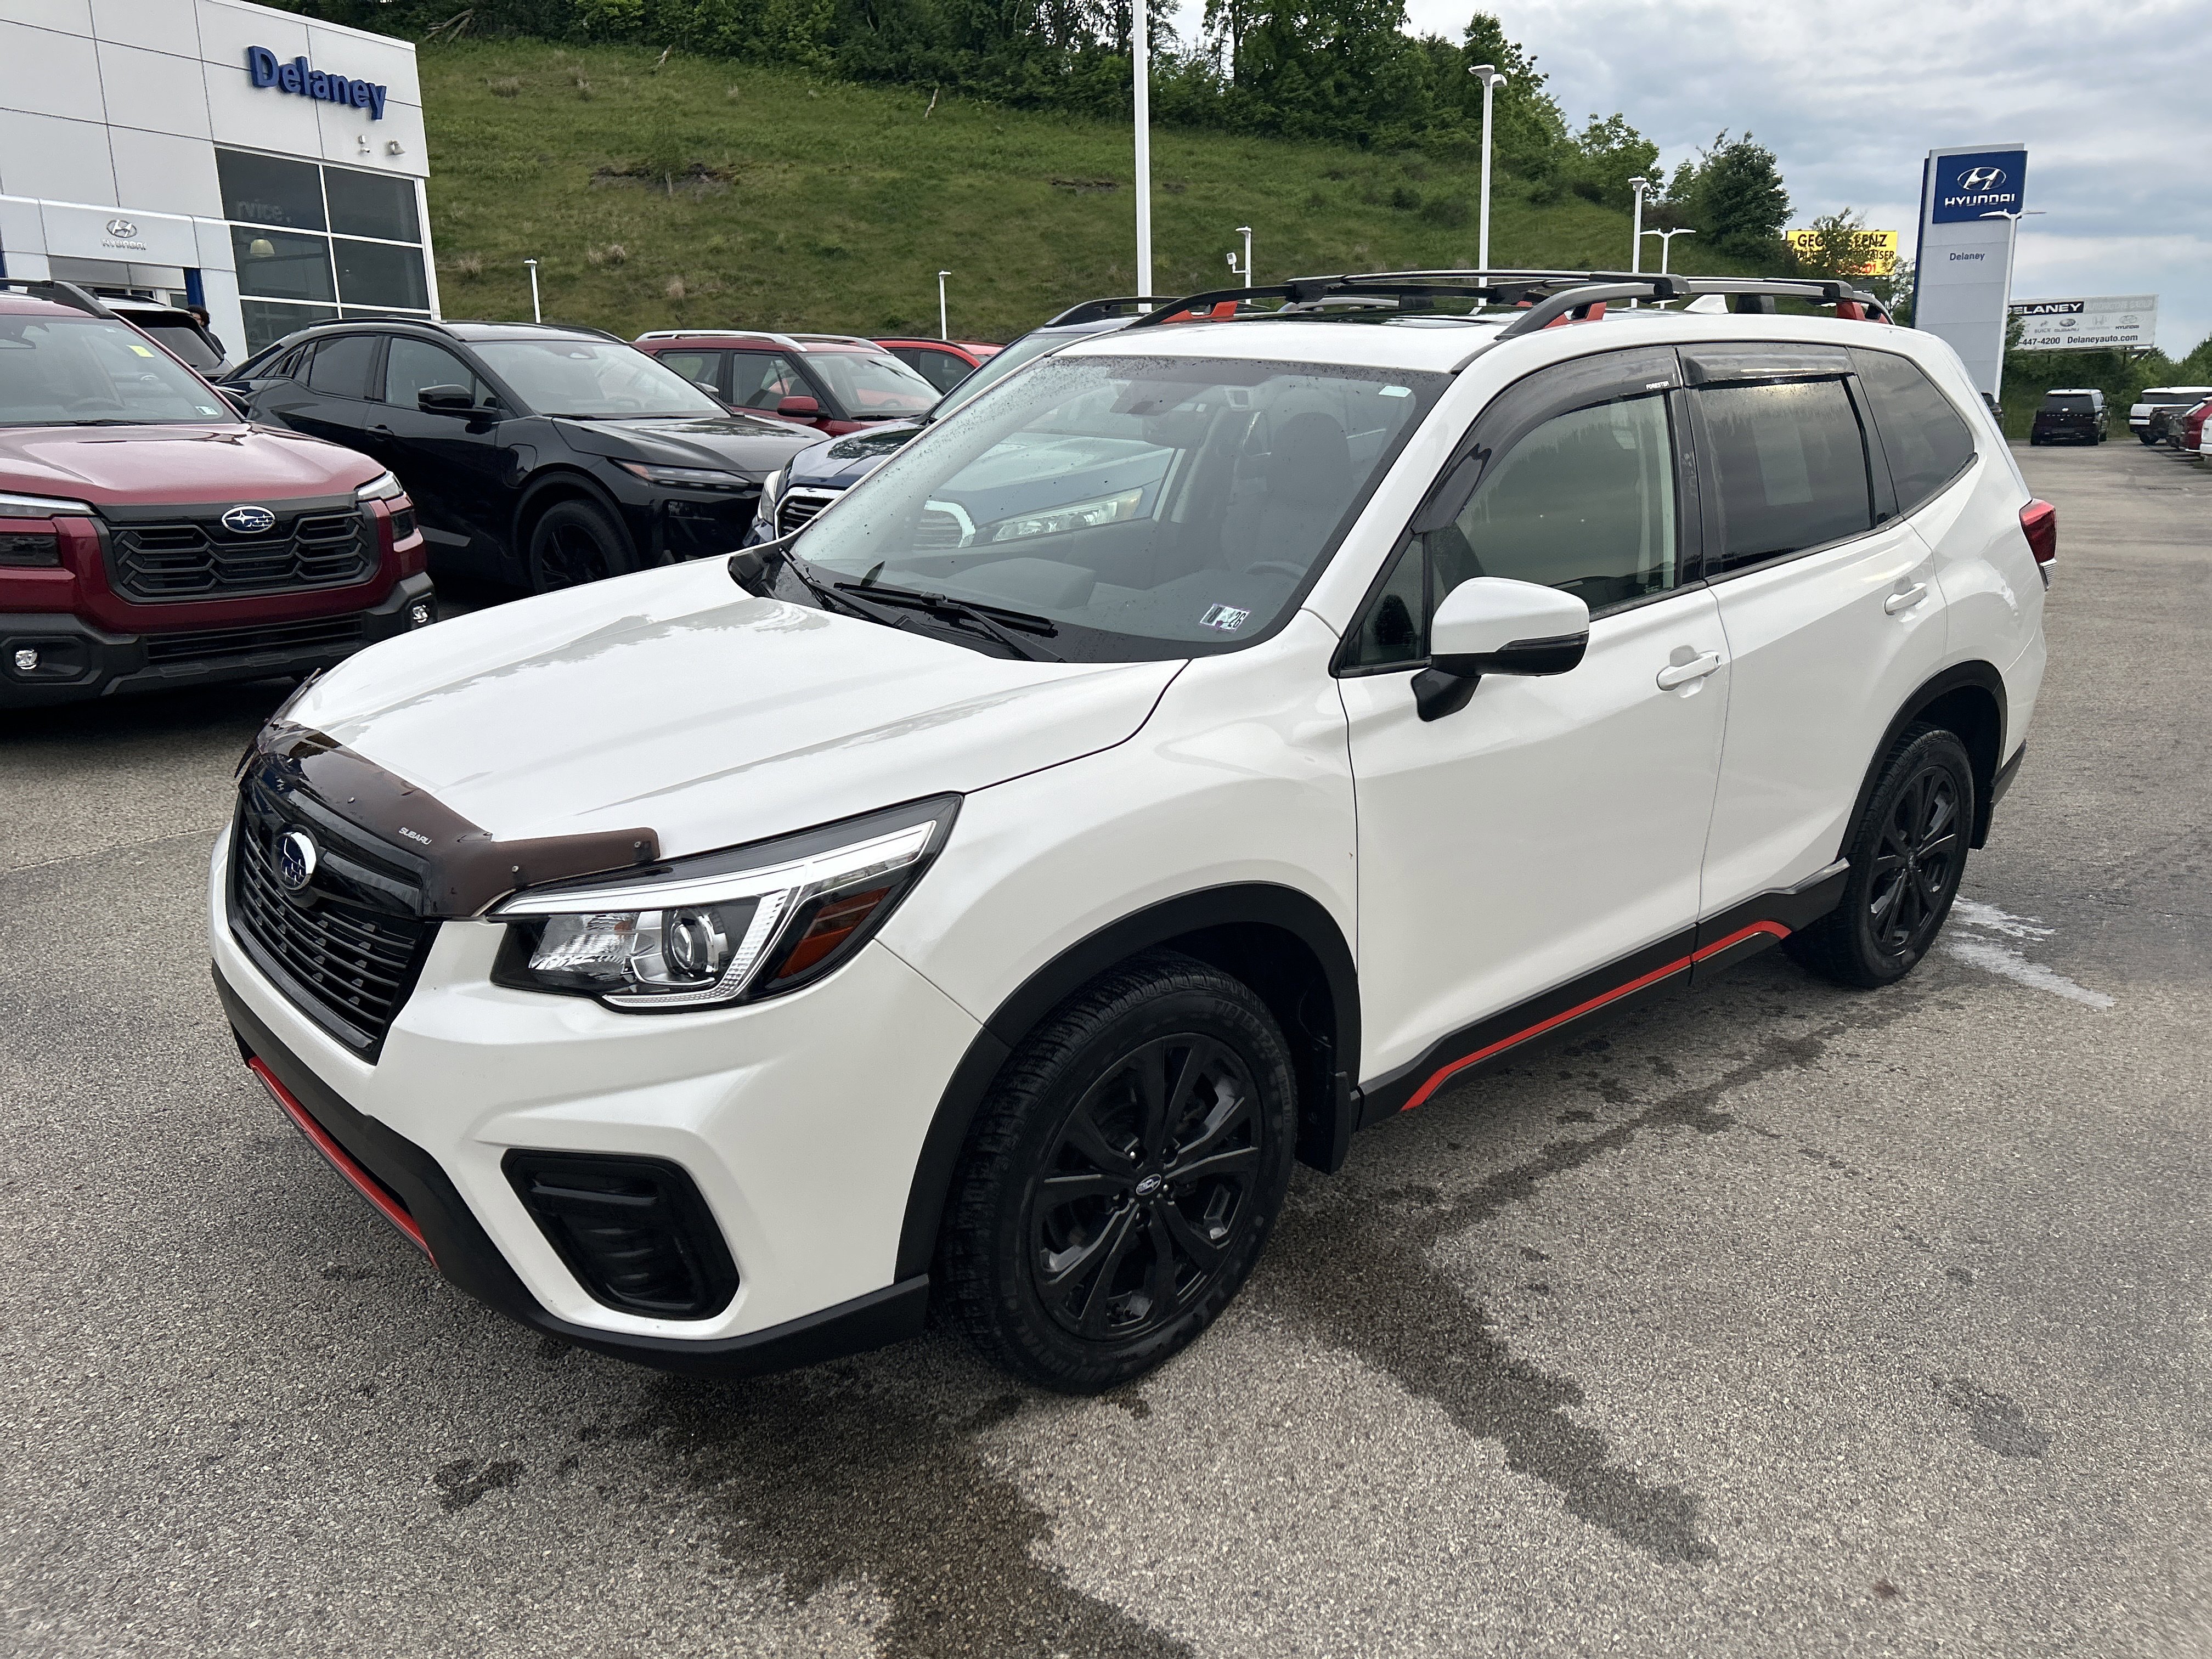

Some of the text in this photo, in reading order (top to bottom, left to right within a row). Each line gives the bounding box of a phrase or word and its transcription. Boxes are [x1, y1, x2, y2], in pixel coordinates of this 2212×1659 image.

[248, 46, 386, 120] Delaney
[1944, 193, 2015, 207] HYUNDAI
[1950, 252, 1985, 261] Delaney
[2067, 335, 2138, 343] Delaneyauto.com
[1228, 611, 1246, 628] 26
[399, 827, 432, 845] SUBARU
